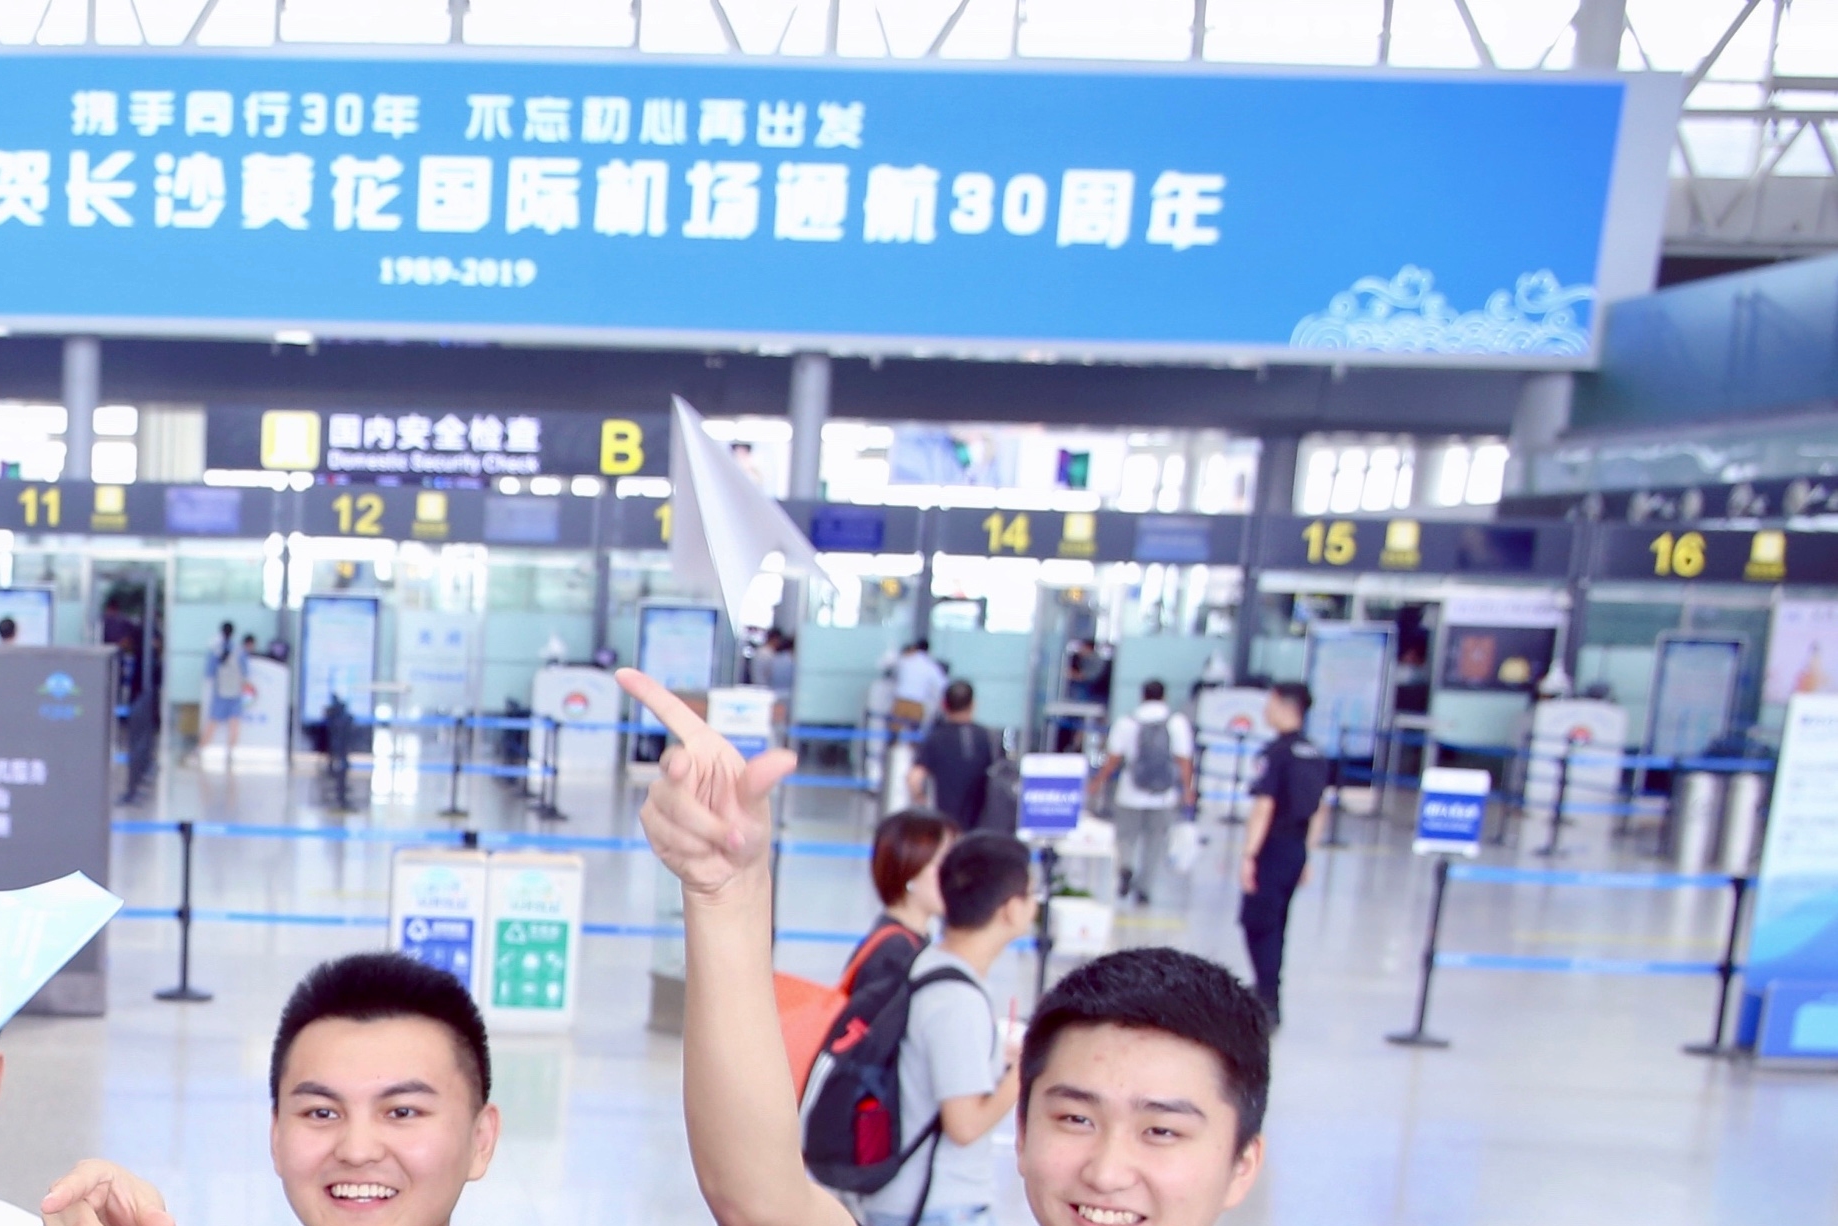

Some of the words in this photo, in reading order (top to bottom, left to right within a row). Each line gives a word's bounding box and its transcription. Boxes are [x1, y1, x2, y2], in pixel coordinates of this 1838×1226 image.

[71, 91, 420, 139] 携手同行30年
[465, 94, 865, 149] 不忘初心再出发
[380, 256, 537, 286] 1989-2019
[328, 413, 542, 453] 国内安全检查
[599, 419, 644, 475] B
[327, 449, 409, 473] Domestic
[409, 451, 481, 476] Security
[482, 451, 541, 475] Check
[18, 487, 61, 527] 11
[333, 494, 384, 535] 12
[654, 503, 672, 541] 1
[982, 512, 1030, 554] 14
[1302, 520, 1357, 566] 15
[1650, 530, 1707, 578] 16
